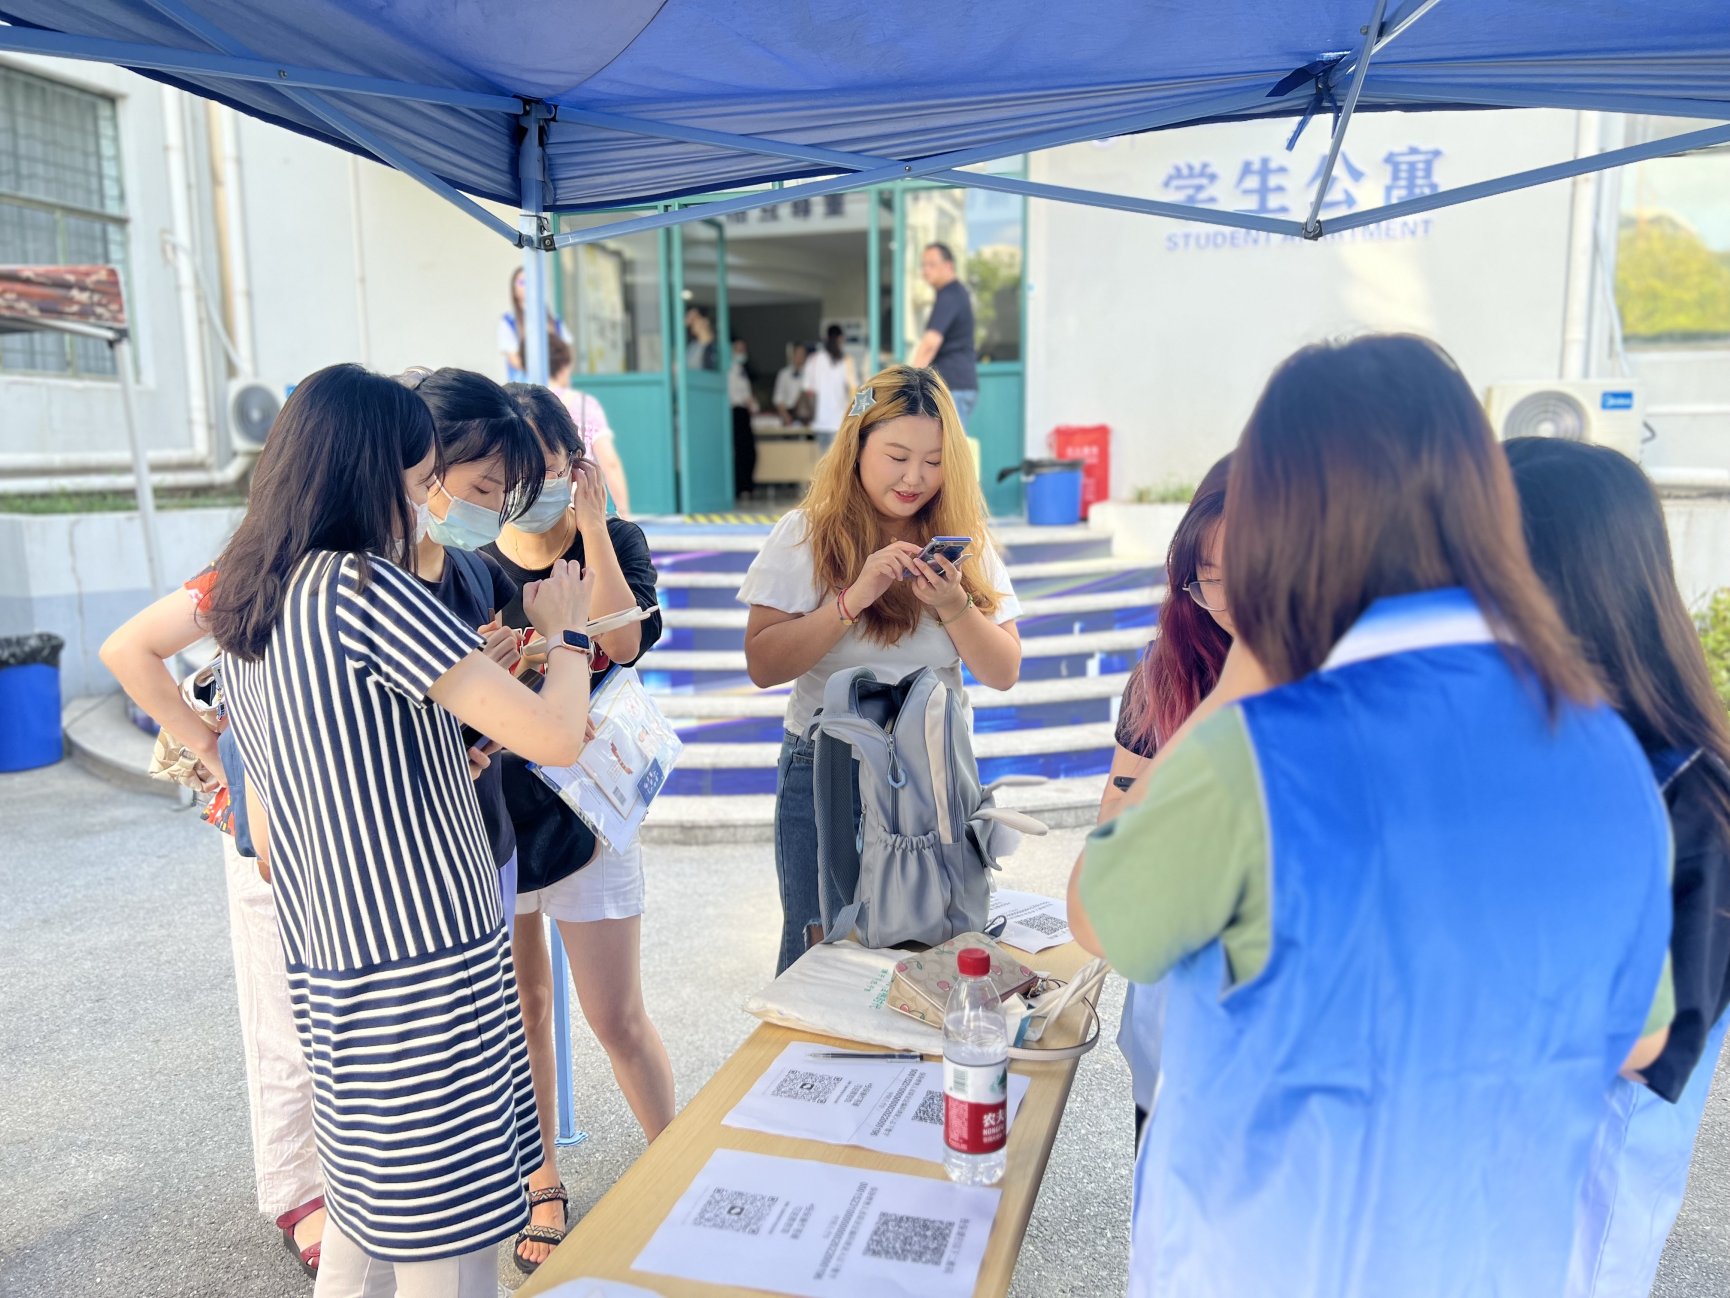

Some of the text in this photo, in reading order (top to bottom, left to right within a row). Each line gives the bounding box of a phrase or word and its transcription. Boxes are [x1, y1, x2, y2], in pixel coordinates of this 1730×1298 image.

[1162, 146, 1444, 214] 学生公寓
[1166, 229, 1272, 251] STUDENT
